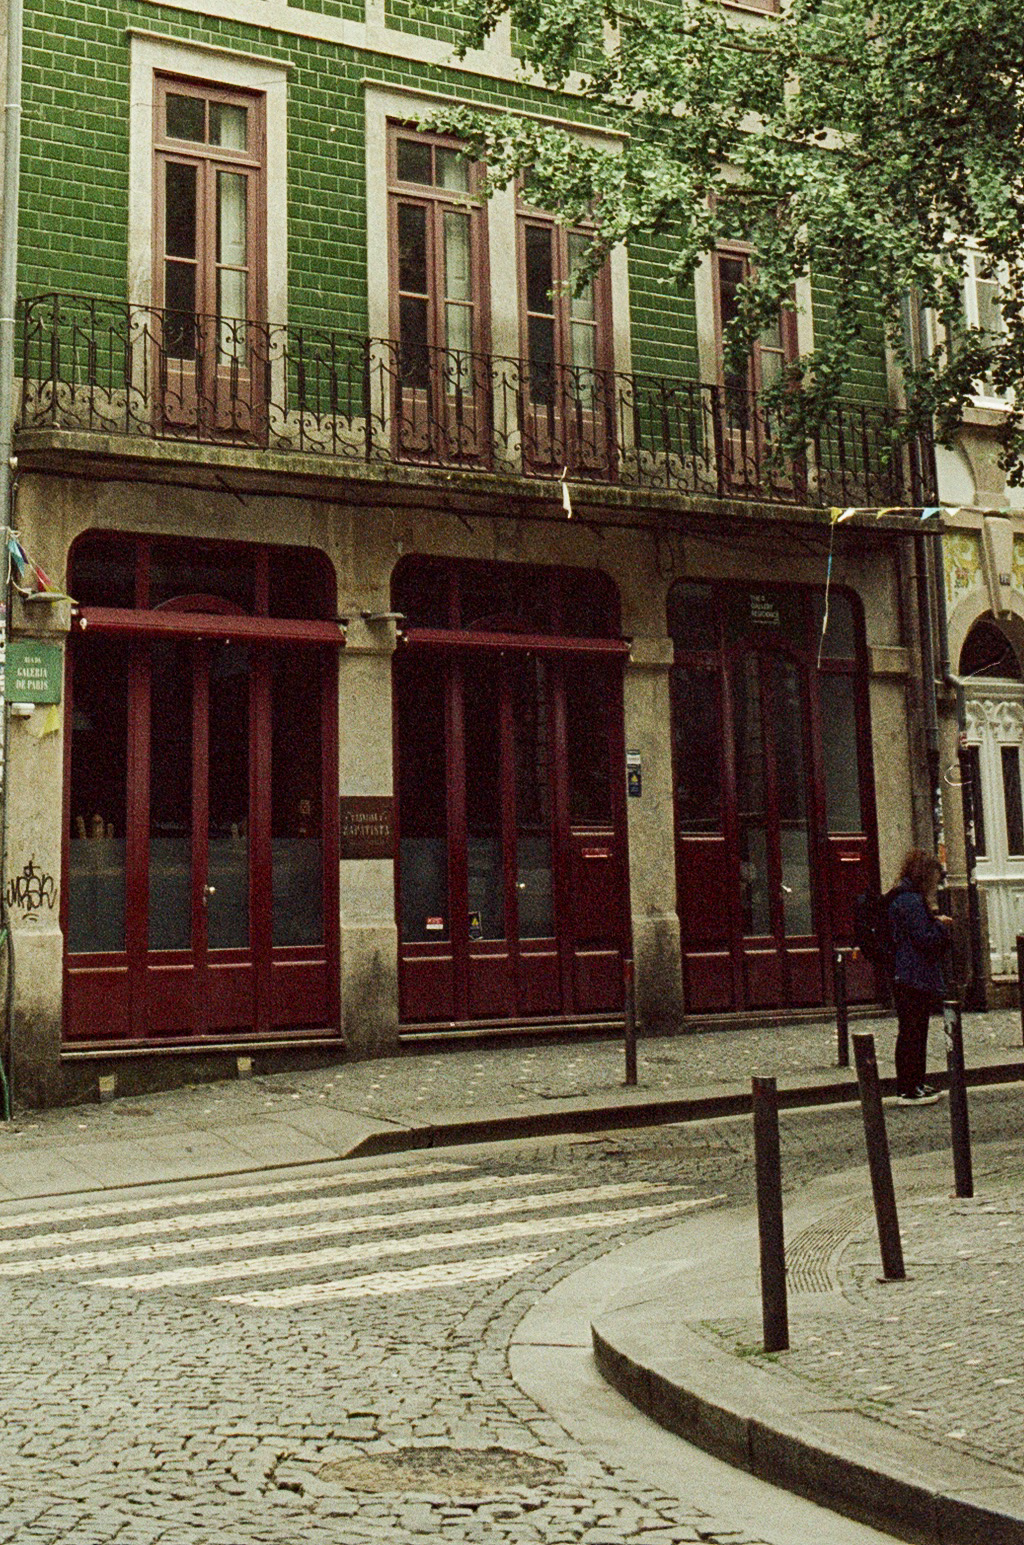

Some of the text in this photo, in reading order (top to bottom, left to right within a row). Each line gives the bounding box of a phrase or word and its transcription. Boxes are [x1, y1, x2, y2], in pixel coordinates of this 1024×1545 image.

[17, 667, 48, 678] GALERIA
[15, 679, 49, 691] DE PARIS
